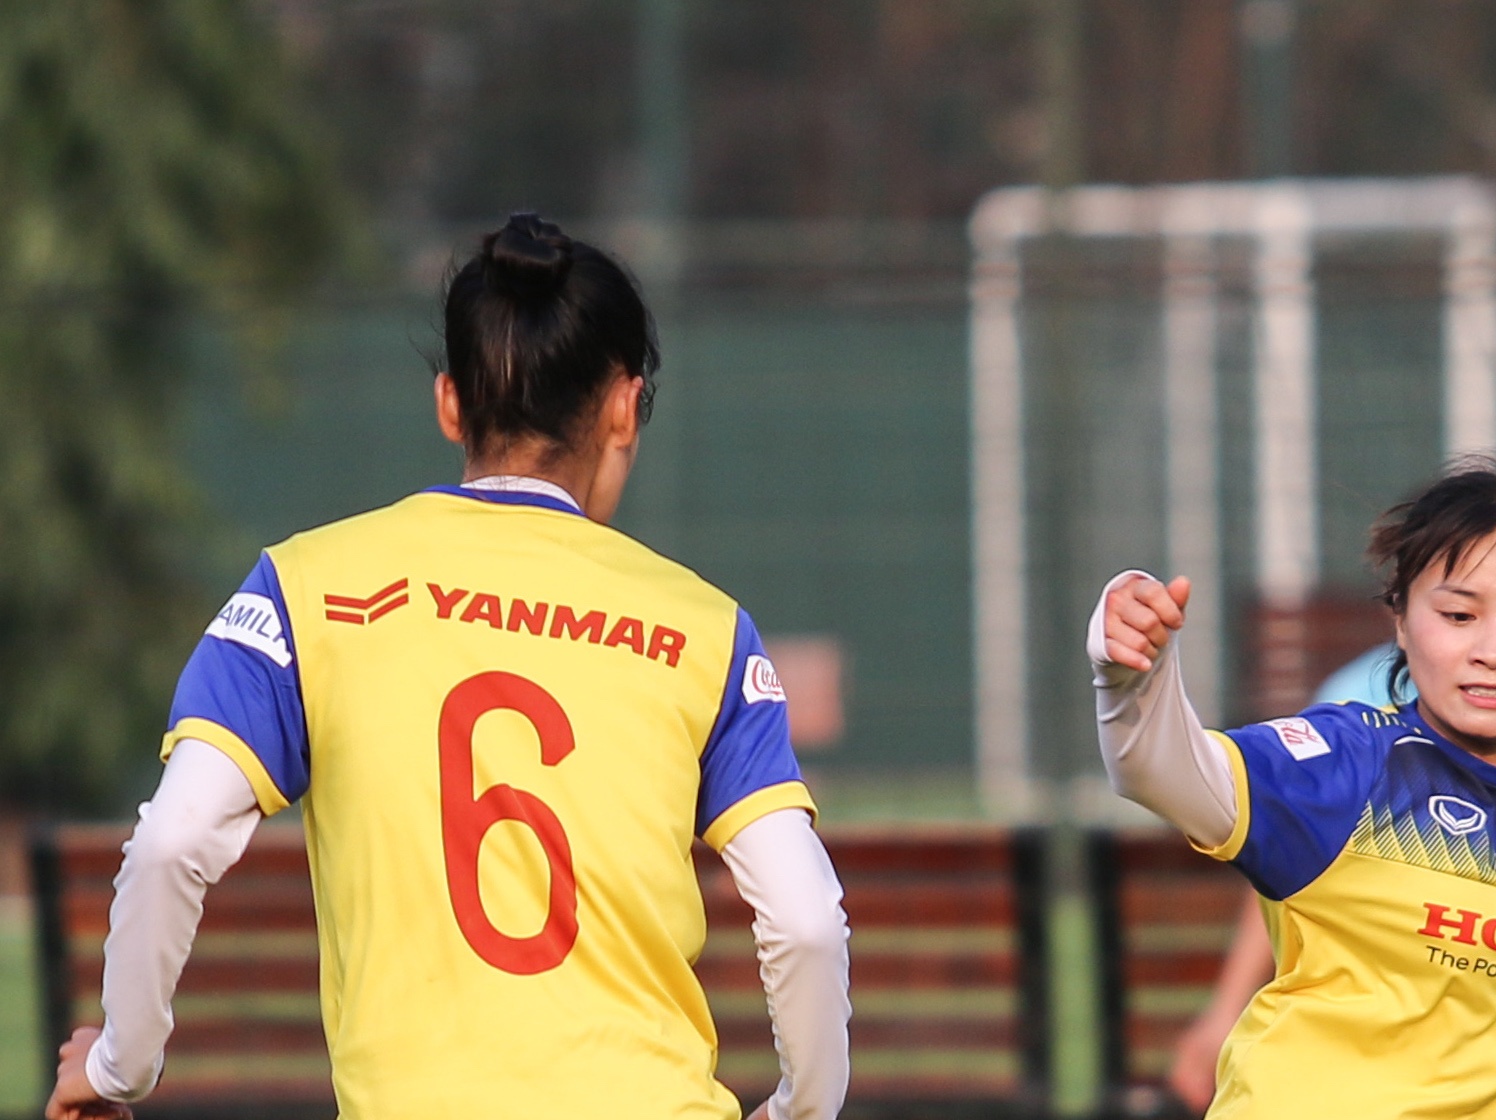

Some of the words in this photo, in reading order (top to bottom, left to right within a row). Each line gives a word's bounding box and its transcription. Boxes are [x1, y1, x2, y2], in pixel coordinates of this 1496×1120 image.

[425, 581, 687, 669] YANMAR
[438, 669, 579, 976] 6
[1425, 945, 1470, 971] The
